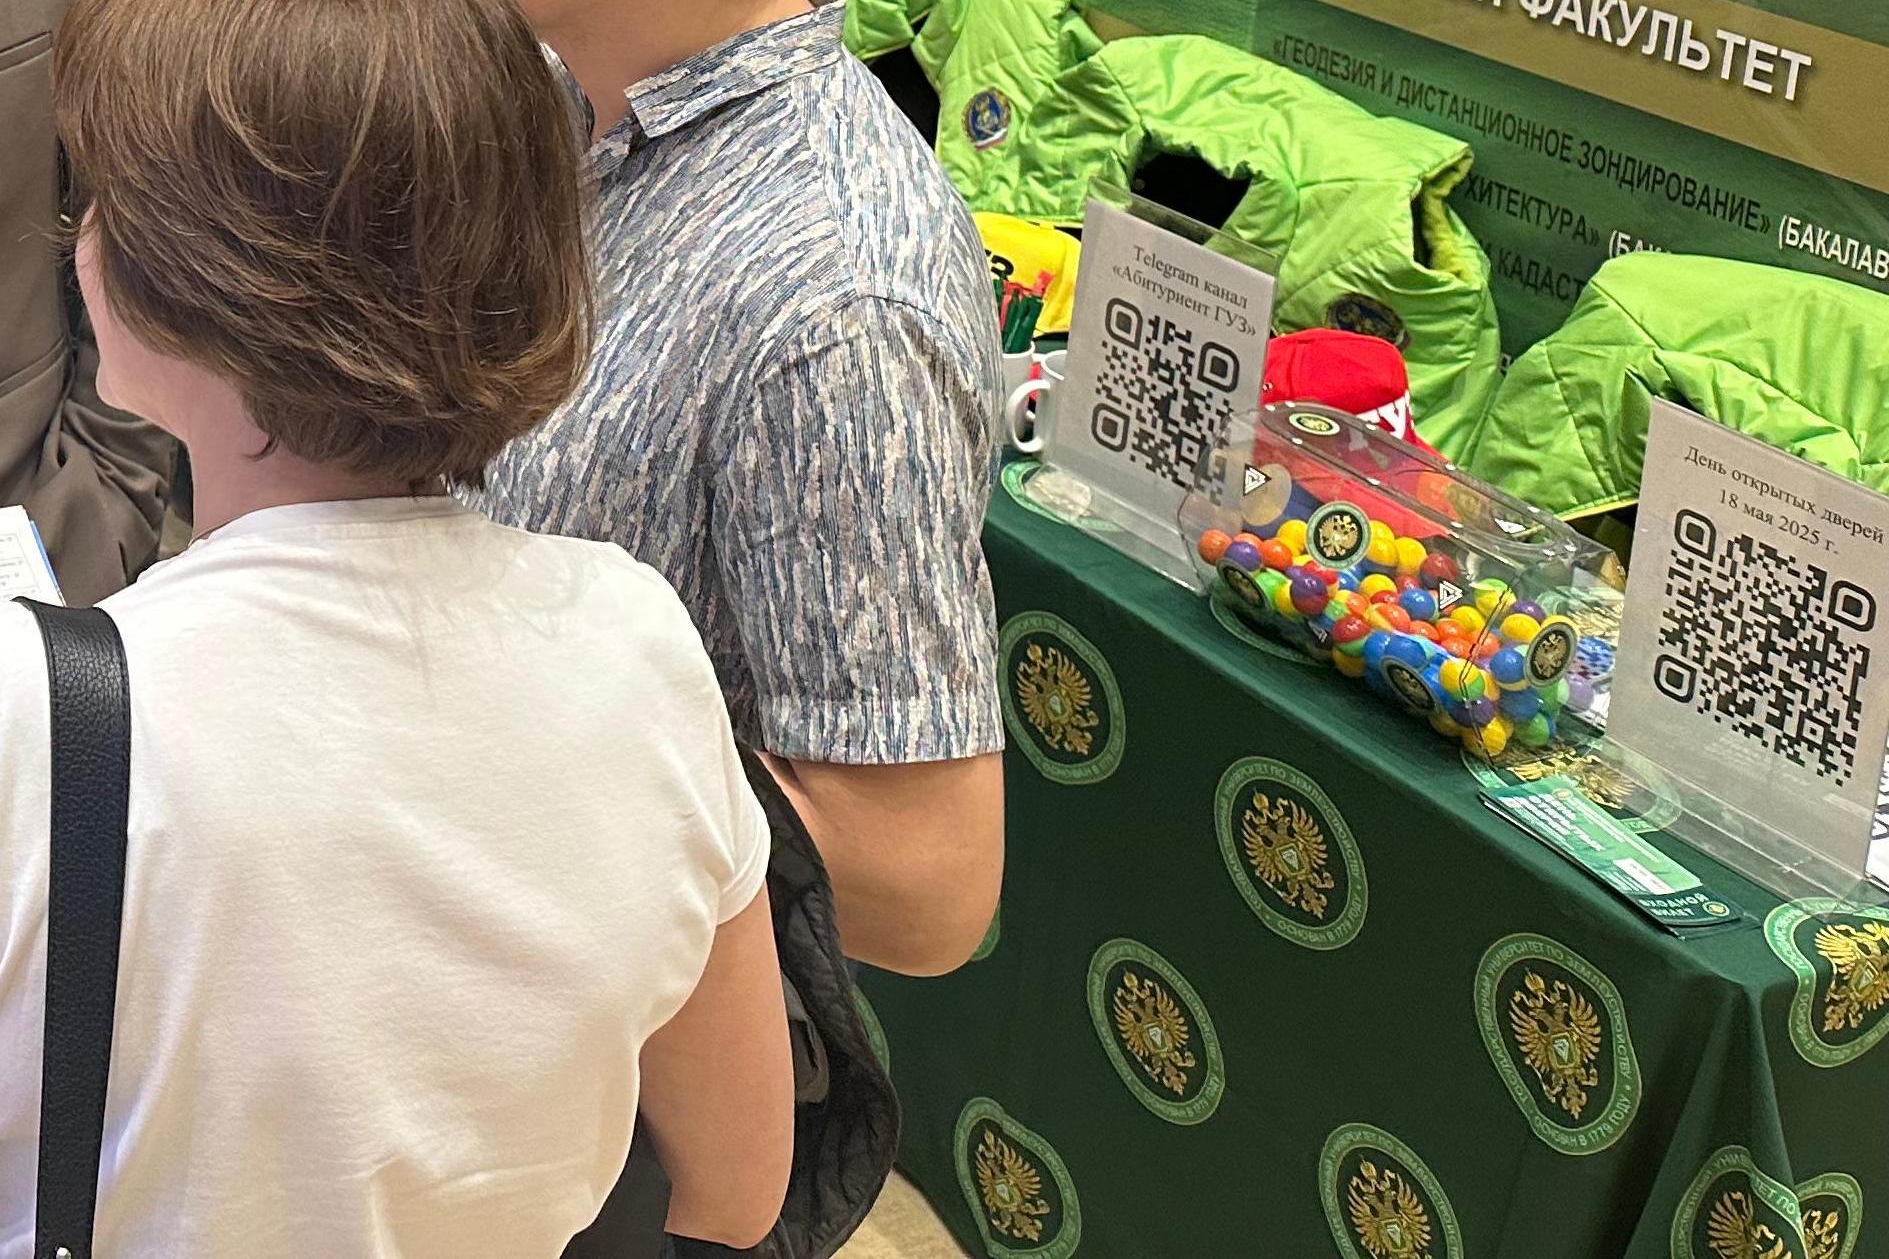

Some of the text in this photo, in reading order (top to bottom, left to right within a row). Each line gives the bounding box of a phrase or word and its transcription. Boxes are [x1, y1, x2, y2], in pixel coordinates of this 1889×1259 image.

[1273, 31, 1771, 235] «ГЕОДЕЗИЯ ДИСТАНЦИОННОЕ ЗОНДИРОВАНИЕ»
[1111, 263, 1257, 337] «Абитуриент ГУЗ»
[1133, 245, 1198, 290] Telegram
[1204, 280, 1248, 310] канал
[1684, 445, 1885, 545] День открытых дверей
[1718, 490, 1840, 554] 18 мая 2025 г.
